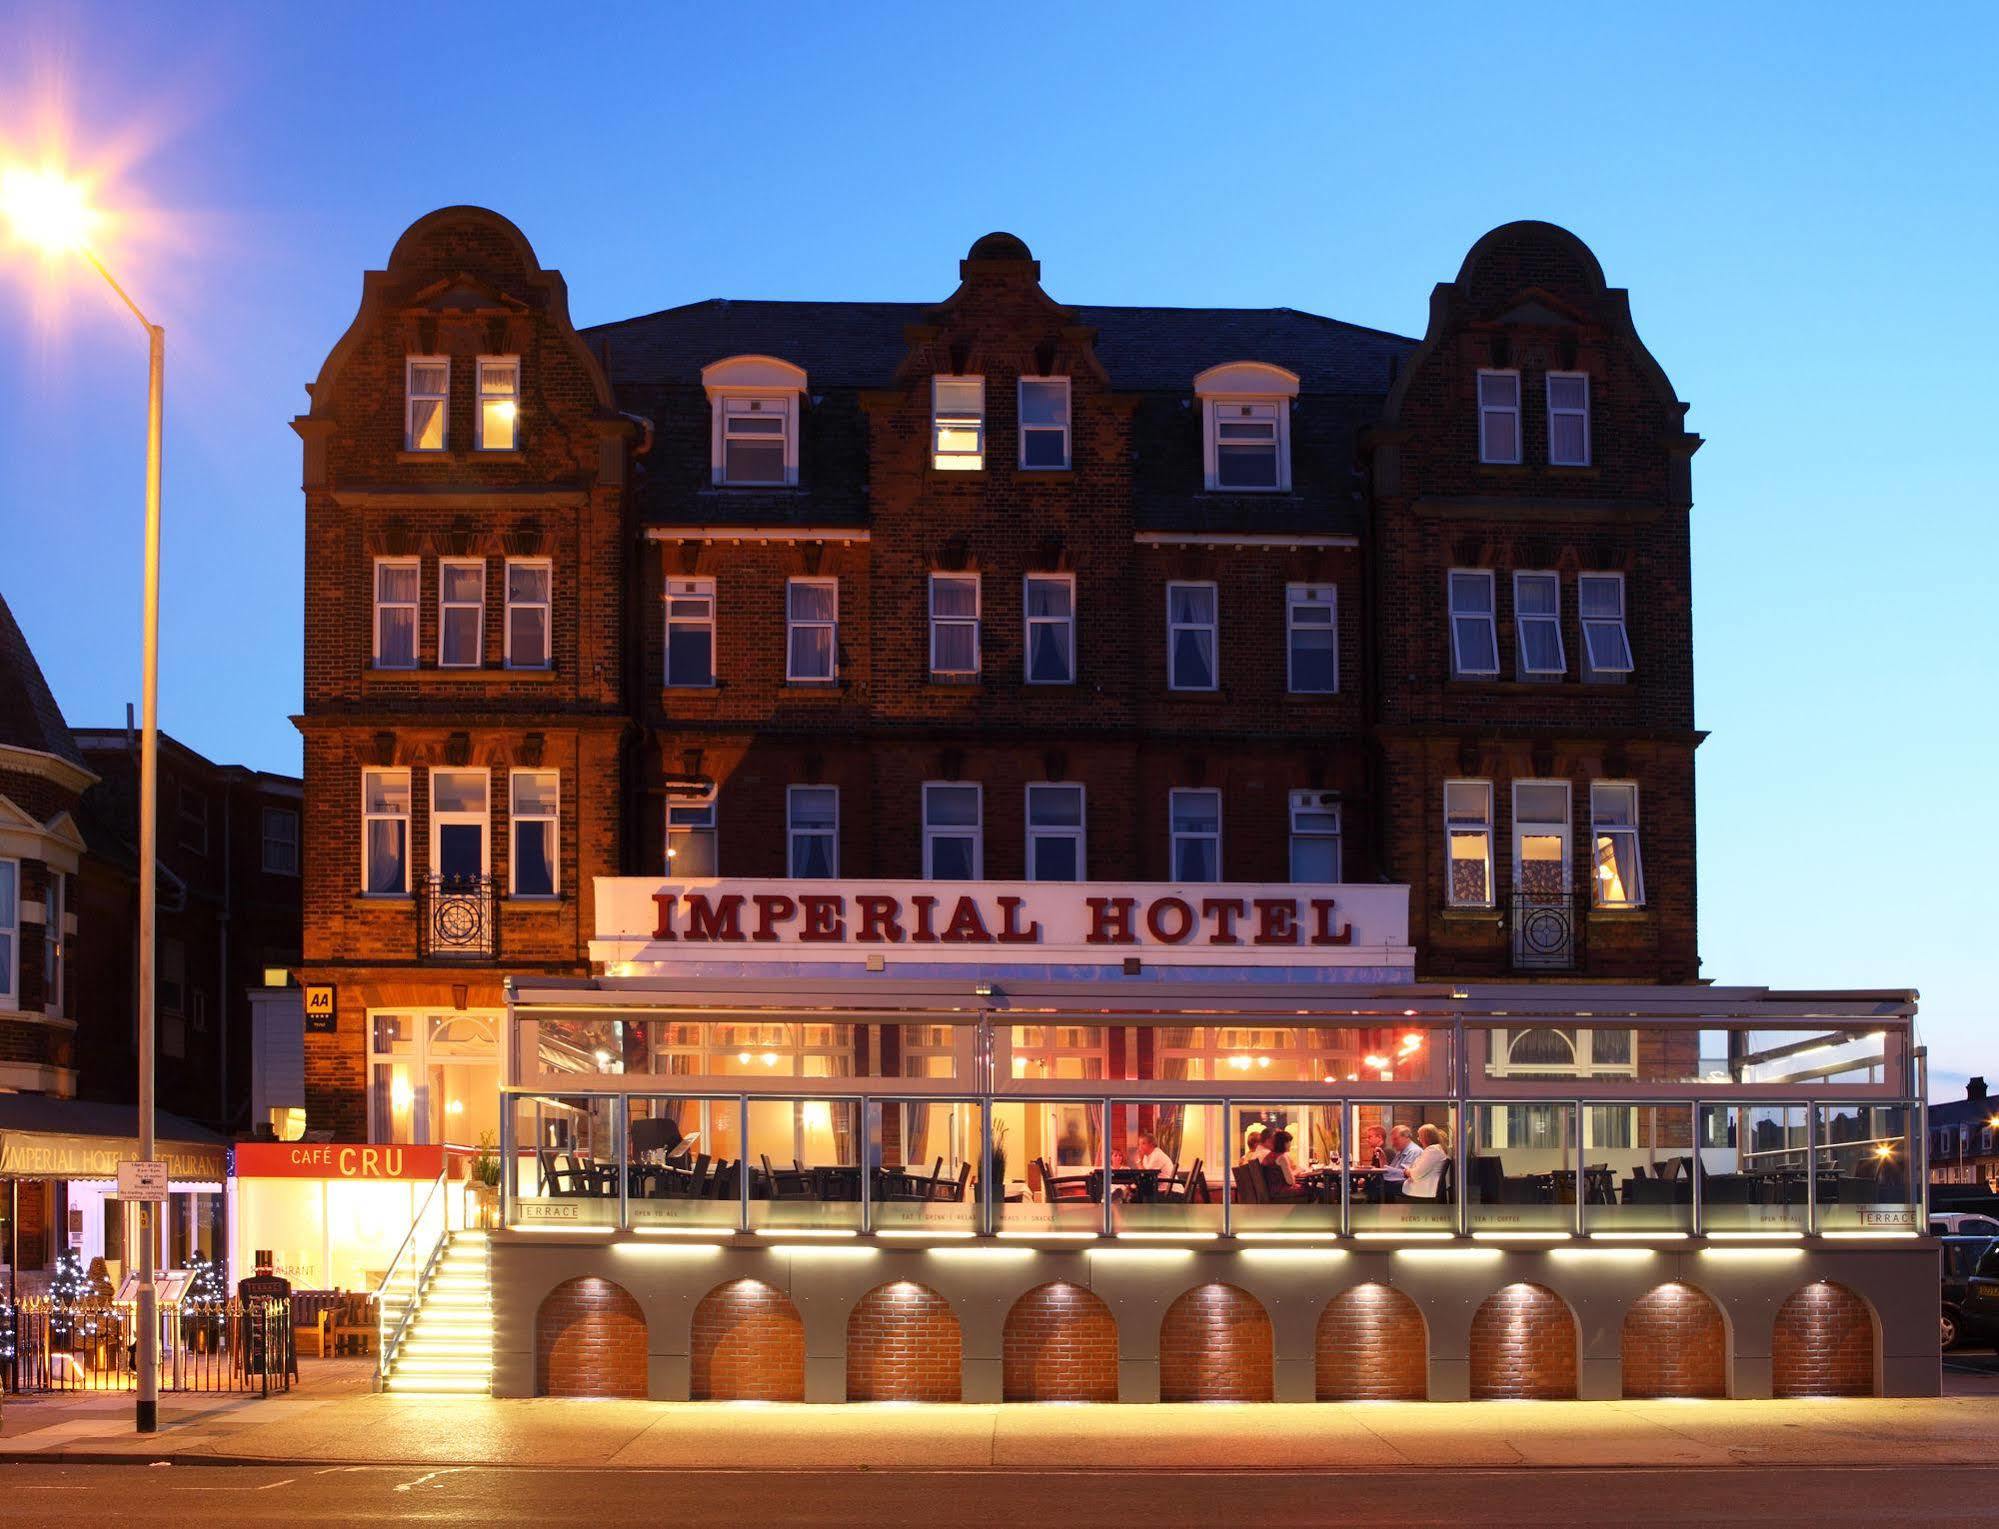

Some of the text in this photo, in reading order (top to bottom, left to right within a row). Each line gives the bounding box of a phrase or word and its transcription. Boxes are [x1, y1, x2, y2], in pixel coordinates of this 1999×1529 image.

[652, 894, 1351, 944] IMPERIAL HOTEL
[310, 993, 328, 1007] AA
[291, 1146, 403, 1176] CAFÉ CRU
[515, 1204, 579, 1218] TERRACE
[1856, 1211, 1916, 1225] TERRACE
